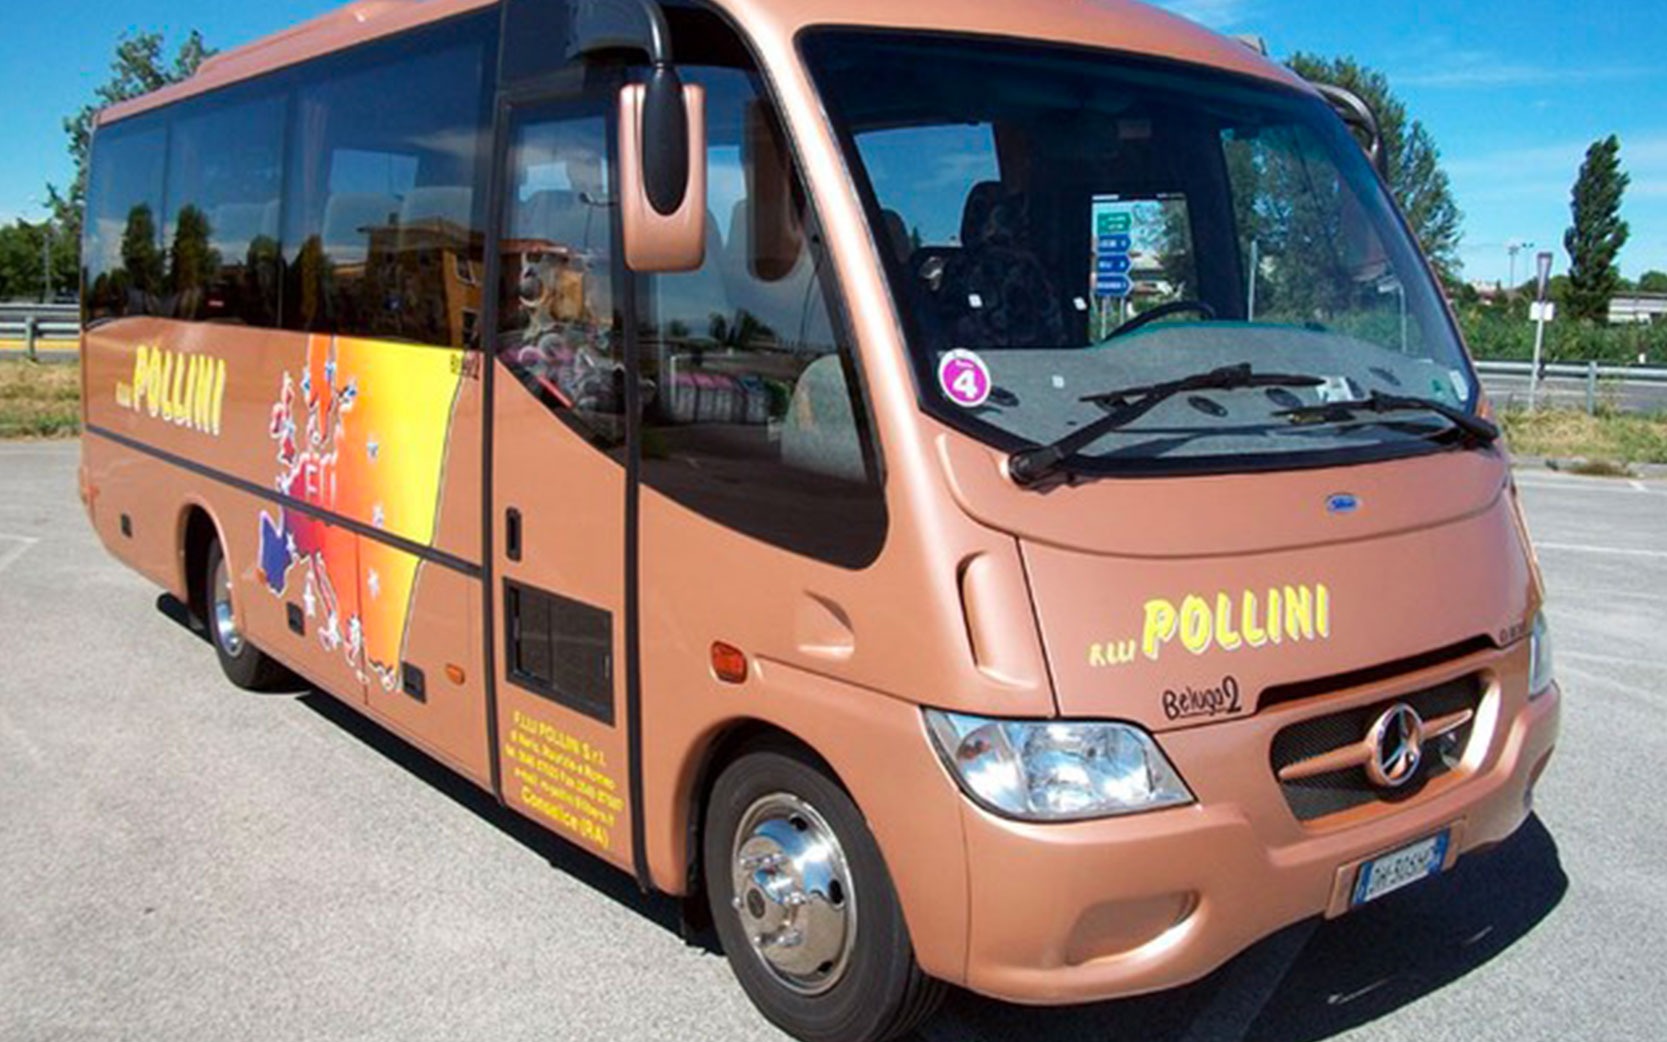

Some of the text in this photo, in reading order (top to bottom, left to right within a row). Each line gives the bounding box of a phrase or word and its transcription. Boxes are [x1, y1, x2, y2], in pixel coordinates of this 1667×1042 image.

[133, 344, 226, 436] POLLINI
[952, 369, 978, 399] 4
[1142, 583, 1329, 660] POLLINI
